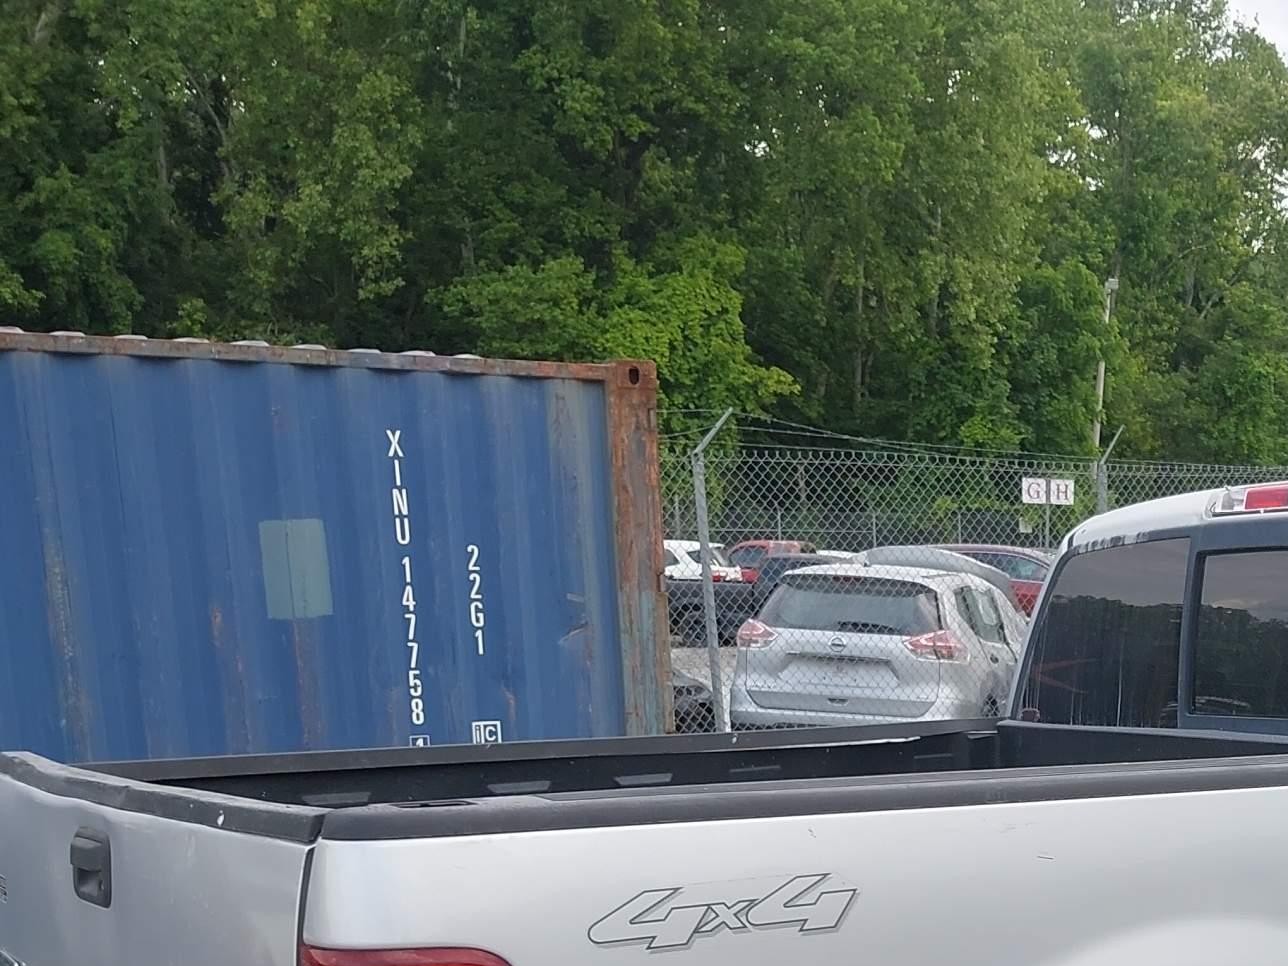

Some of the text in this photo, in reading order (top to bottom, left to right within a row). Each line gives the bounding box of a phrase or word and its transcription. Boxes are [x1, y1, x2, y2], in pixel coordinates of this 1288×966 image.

[1027, 482, 1069, 500] G H
[386, 429, 410, 545] XINU
[402, 556, 425, 725] 147758
[467, 544, 485, 655] 22G1
[588, 872, 858, 951] 4x4
